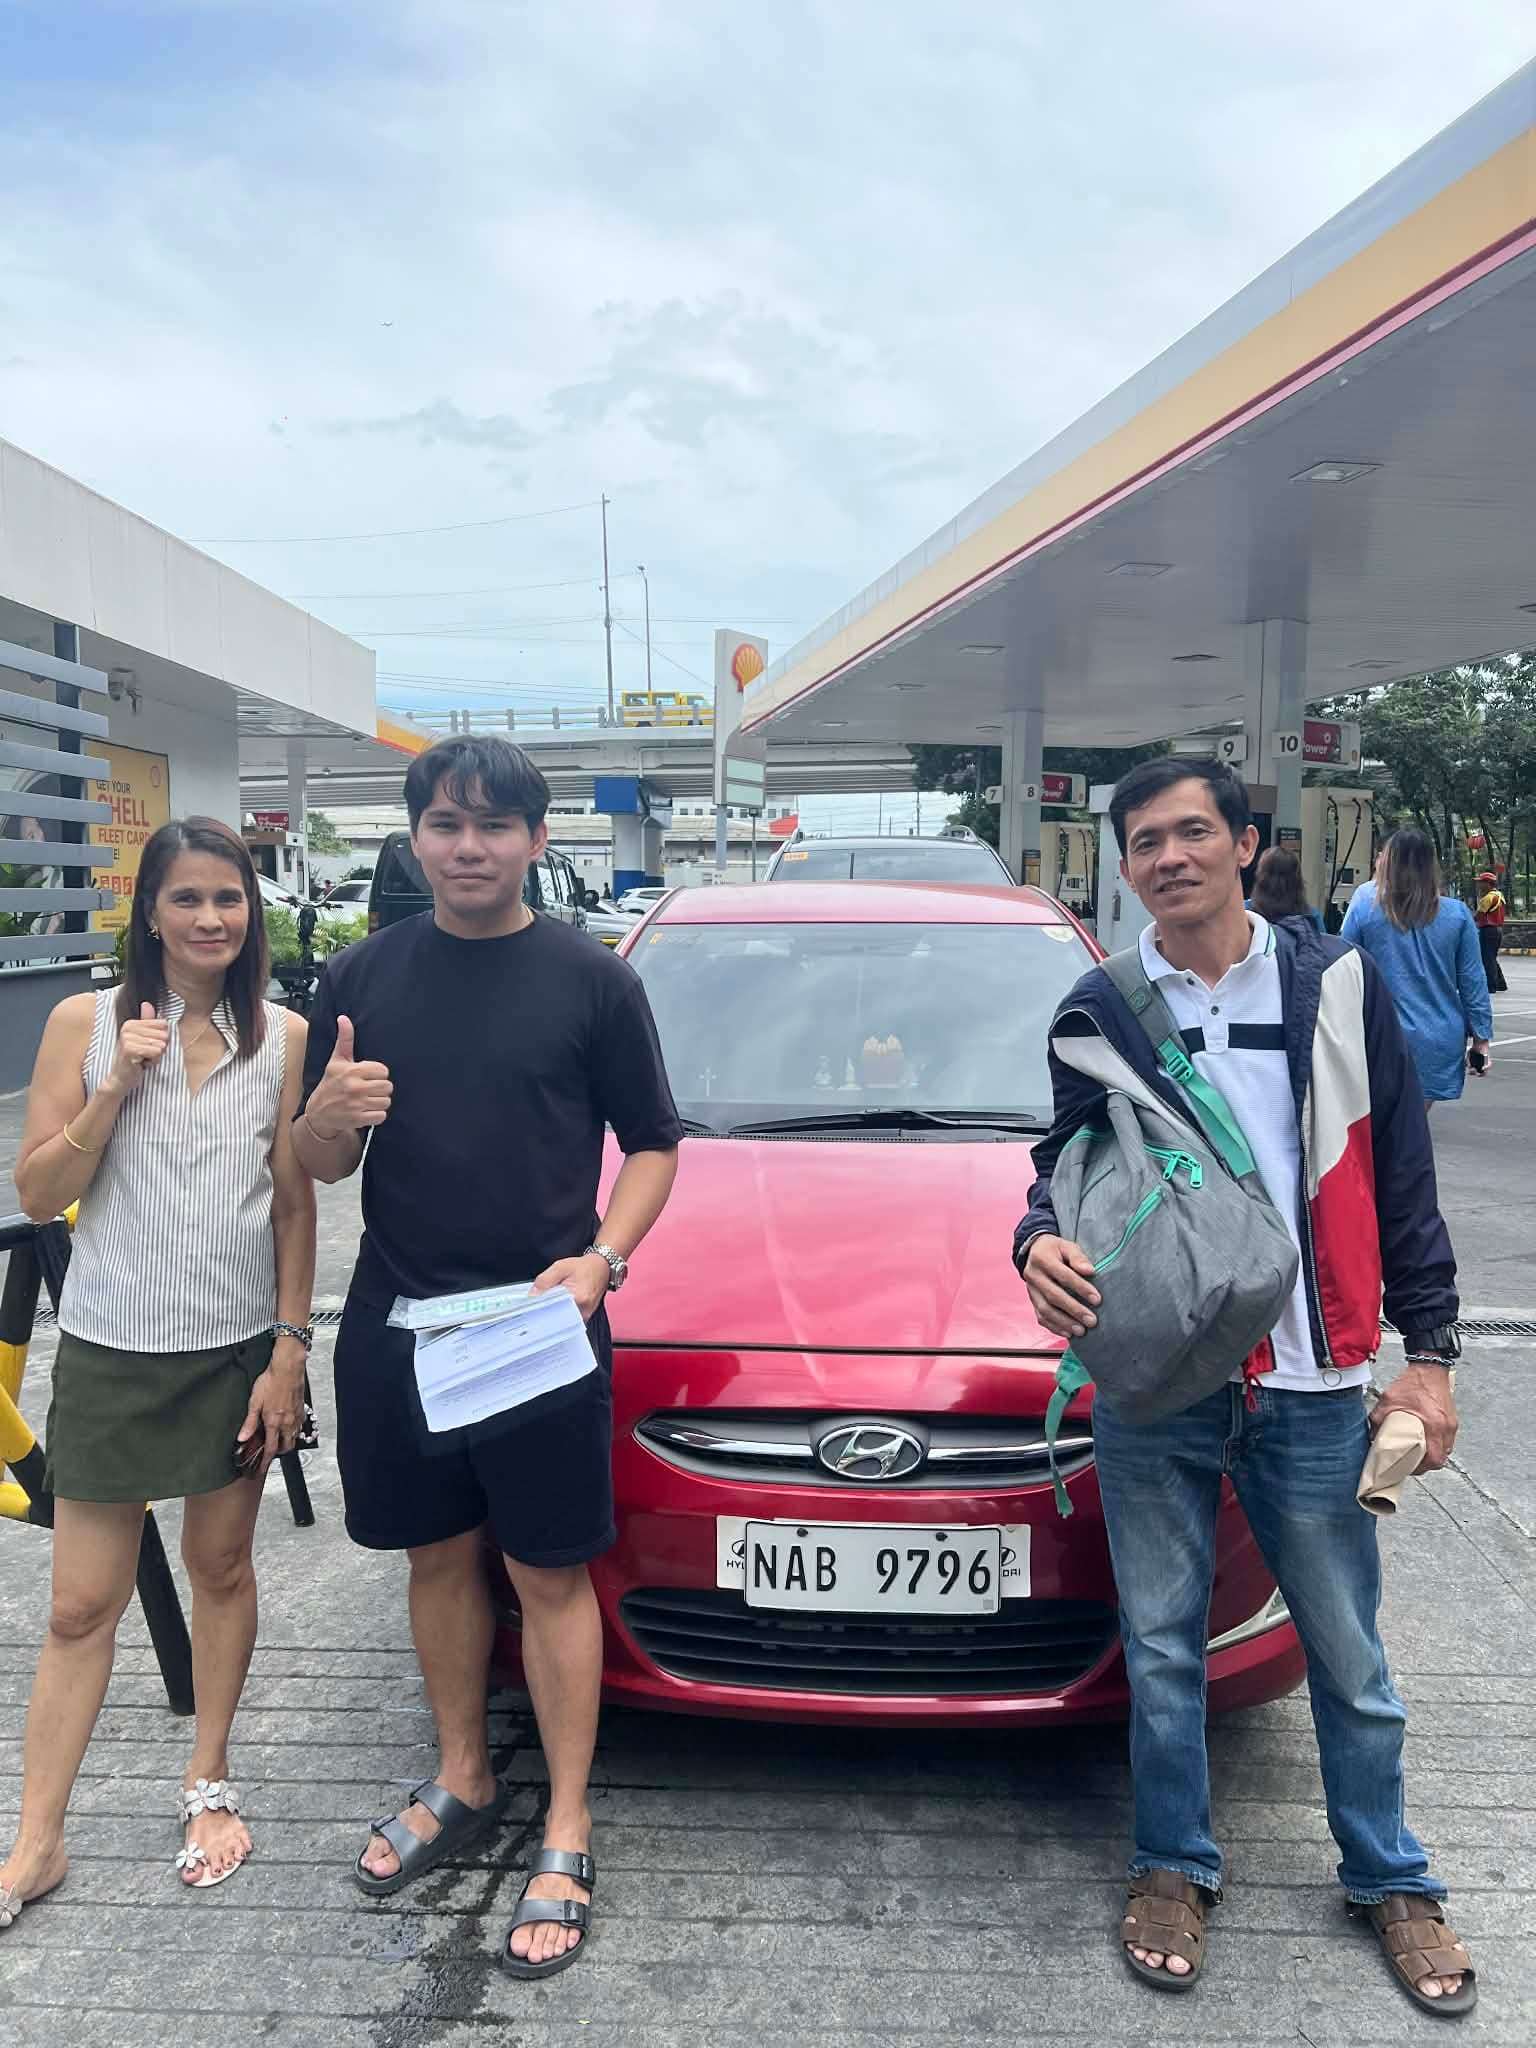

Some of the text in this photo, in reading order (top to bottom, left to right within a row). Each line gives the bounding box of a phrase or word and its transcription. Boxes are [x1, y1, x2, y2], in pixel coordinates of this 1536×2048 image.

[1223, 741, 1234, 757] 9
[1279, 735, 1298, 752] 10
[1302, 743, 1328, 754] ower
[990, 790, 996, 800] 7
[1027, 786, 1034, 798] 8
[98, 827, 125, 845] FLEET
[754, 1543, 991, 1595] NAB 9796
